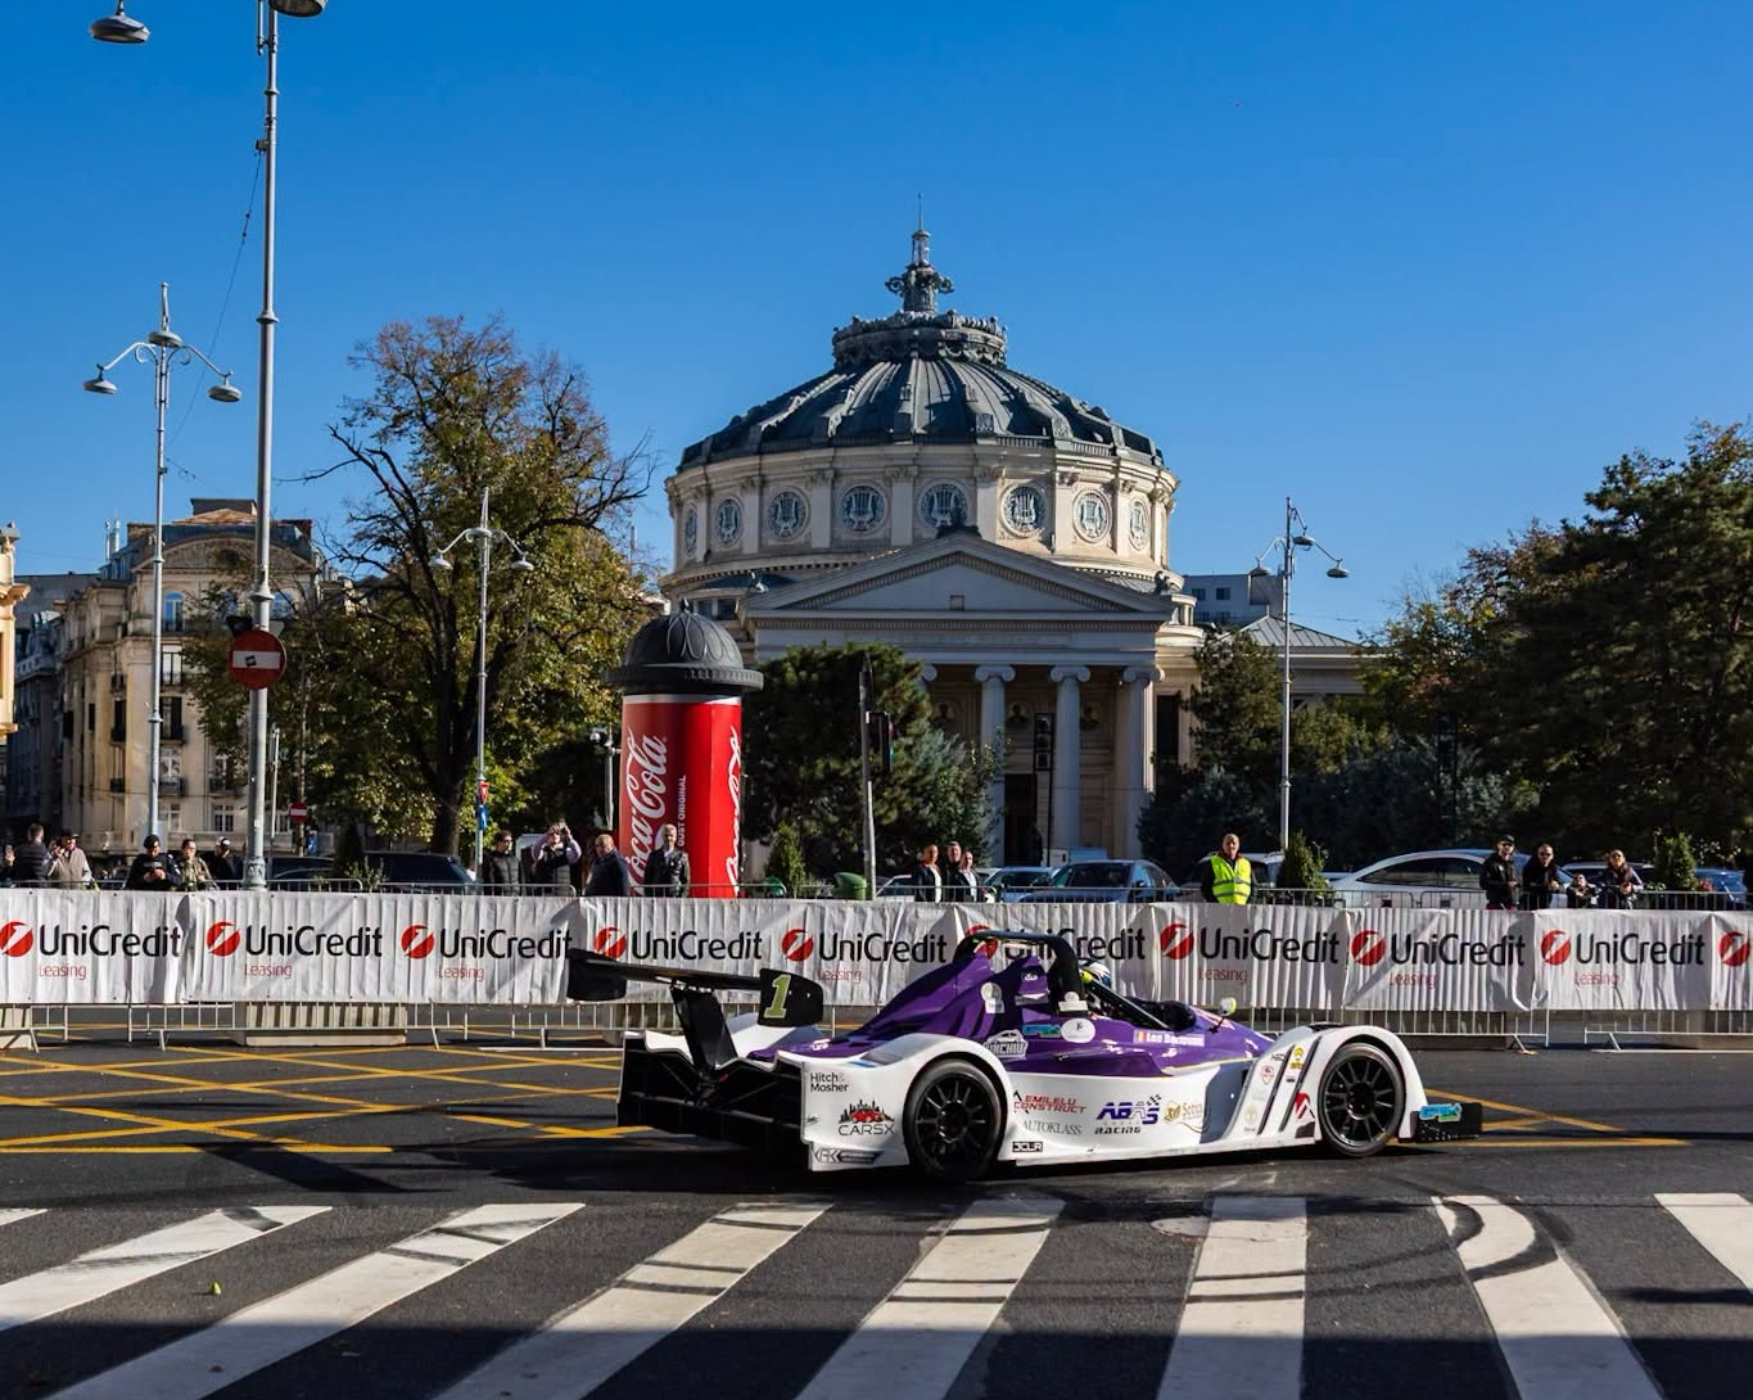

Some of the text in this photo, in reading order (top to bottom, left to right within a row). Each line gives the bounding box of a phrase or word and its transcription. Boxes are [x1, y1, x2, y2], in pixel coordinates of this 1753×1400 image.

[39, 924, 182, 958] UniCredit
[245, 925, 383, 958] UniCredit
[440, 928, 573, 960] UniCredit
[632, 930, 762, 960] UniCredit
[818, 931, 947, 964] UniCredit
[1200, 927, 1340, 965] UniCredit
[1391, 933, 1526, 966] UniCredit
[1576, 933, 1705, 966] UniCredit
[38, 962, 87, 980] Leasing
[244, 962, 293, 980] Leasing
[437, 965, 485, 982] Leasing
[1198, 967, 1248, 984] Leasing
[763, 973, 790, 1019] 1
[810, 1082, 848, 1093] Mosher
[838, 1123, 895, 1136] CARSX
